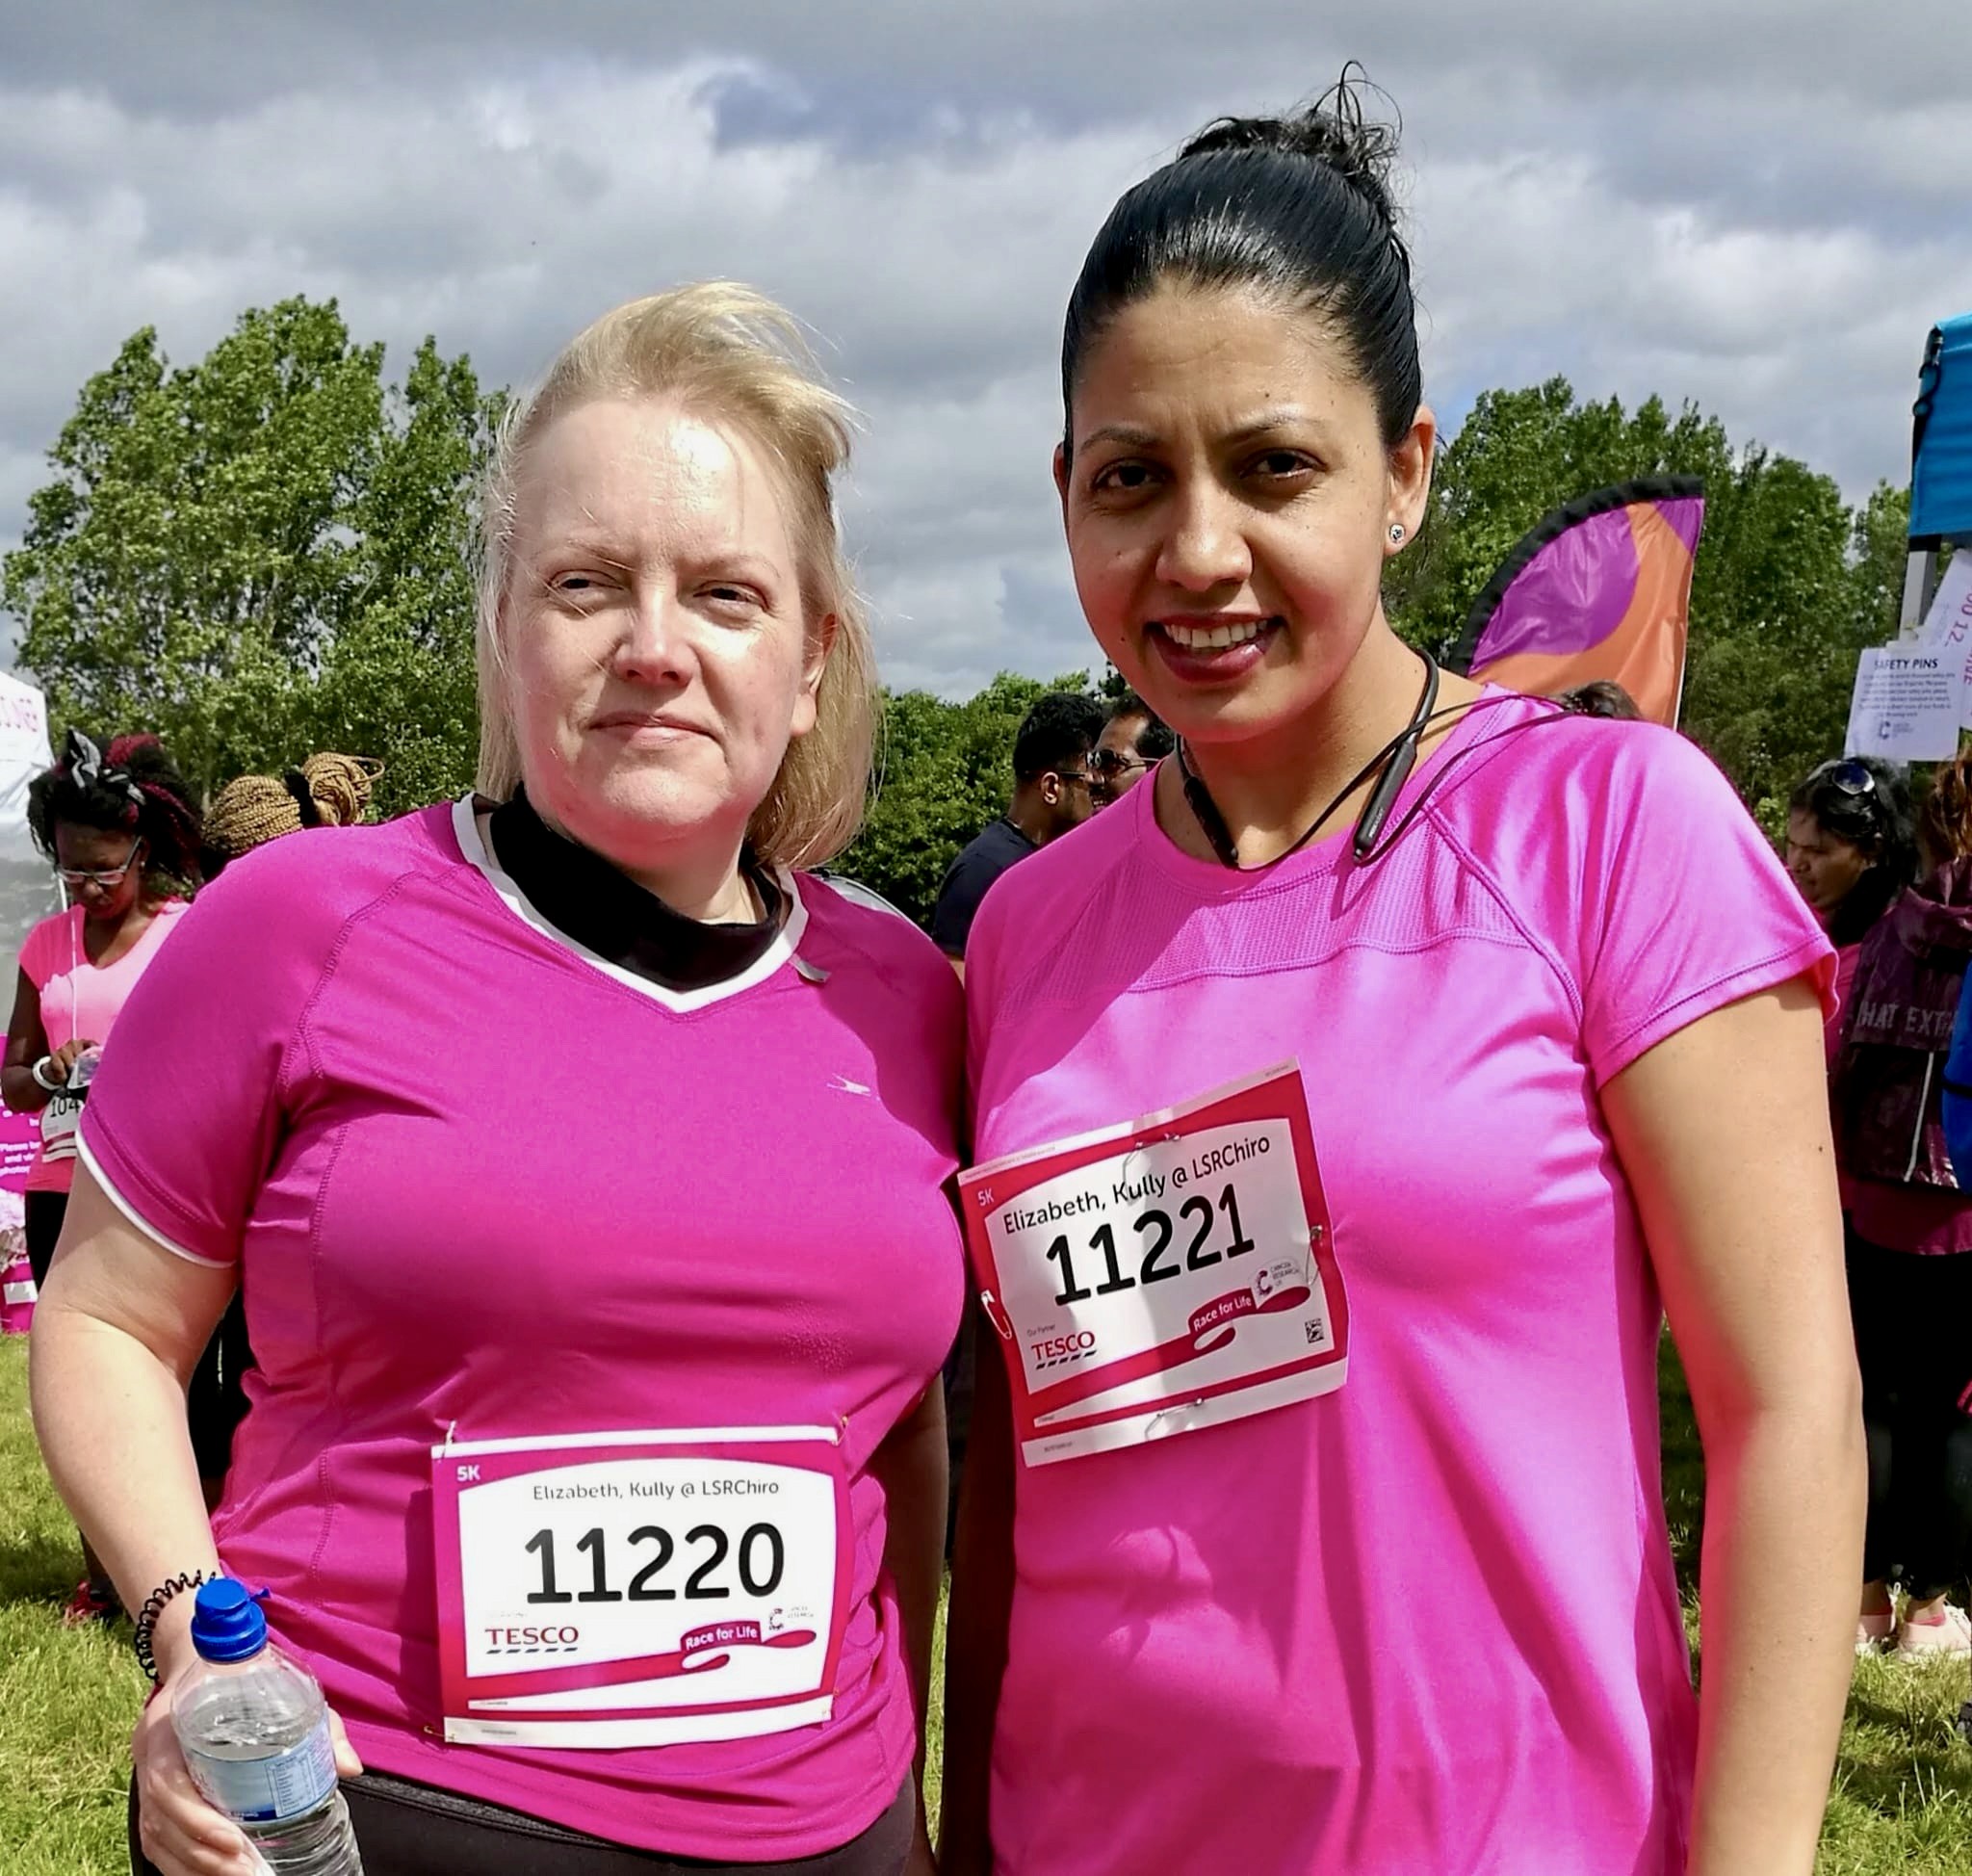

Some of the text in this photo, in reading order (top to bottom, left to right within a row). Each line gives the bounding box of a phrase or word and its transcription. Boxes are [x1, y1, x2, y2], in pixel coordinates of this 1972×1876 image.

[1874, 658, 1939, 670] SAFETY PINS
[977, 1188, 995, 1207] 5K
[1003, 1135, 1271, 1235] Elizabeth, Kully @ LSRChiro
[1046, 1183, 1256, 1306] 11221
[1193, 1295, 1252, 1332] Race for Life
[1030, 1331, 1096, 1361] TESCO
[456, 1465, 480, 1482] 5K
[532, 1479, 780, 1501] Elizabeth, Kully @ LSRChiro
[525, 1522, 785, 1604] 11220
[484, 1626, 580, 1646] TESCO
[685, 1625, 758, 1651] Race for Life
